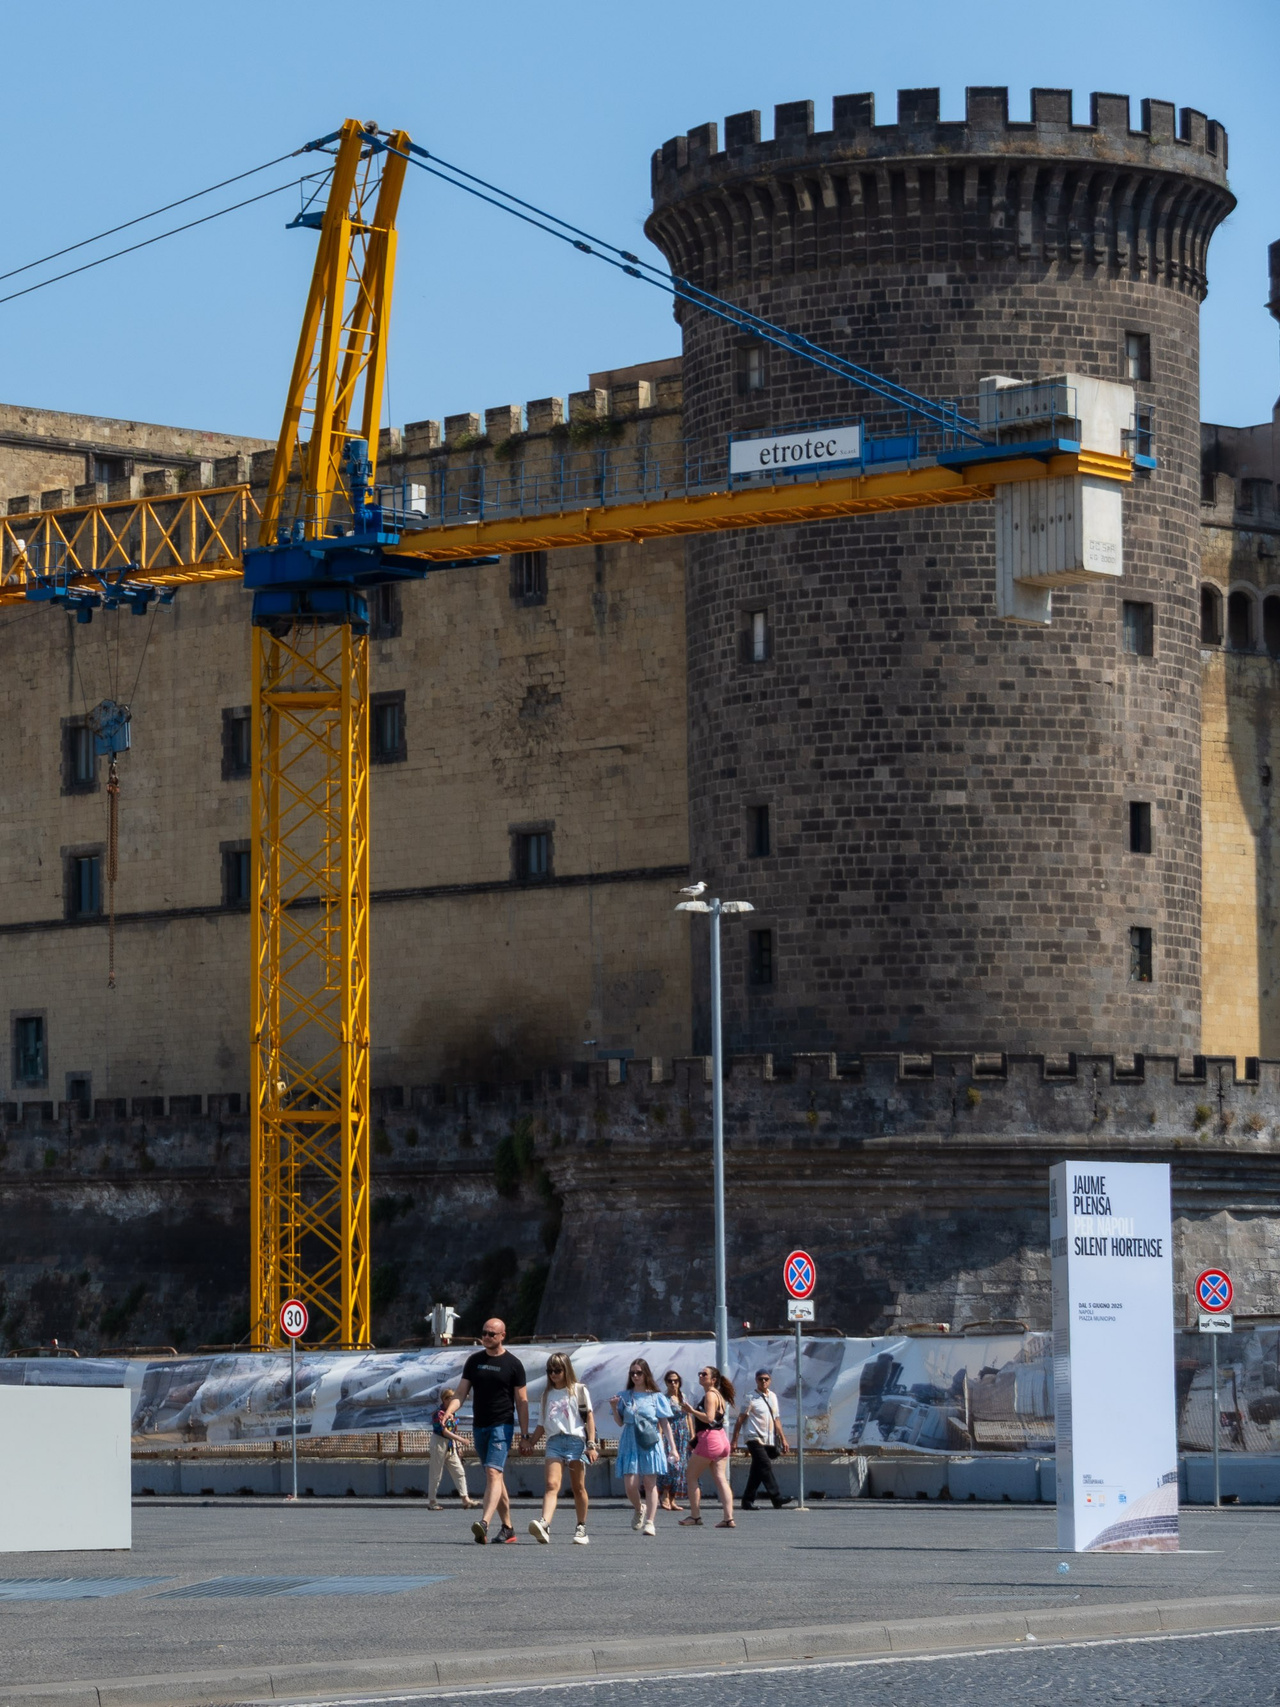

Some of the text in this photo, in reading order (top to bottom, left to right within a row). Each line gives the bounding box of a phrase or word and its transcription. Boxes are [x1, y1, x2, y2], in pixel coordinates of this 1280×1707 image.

[759, 438, 837, 465] etrotec
[1072, 1175, 1107, 1195] JAUME
[1073, 1196, 1112, 1215] PLENSA
[1074, 1216, 1135, 1237] PER NAPOLI
[1074, 1236, 1108, 1256] SILENT
[1111, 1238, 1163, 1258] HORTENSE
[286, 1310, 302, 1327] 30
